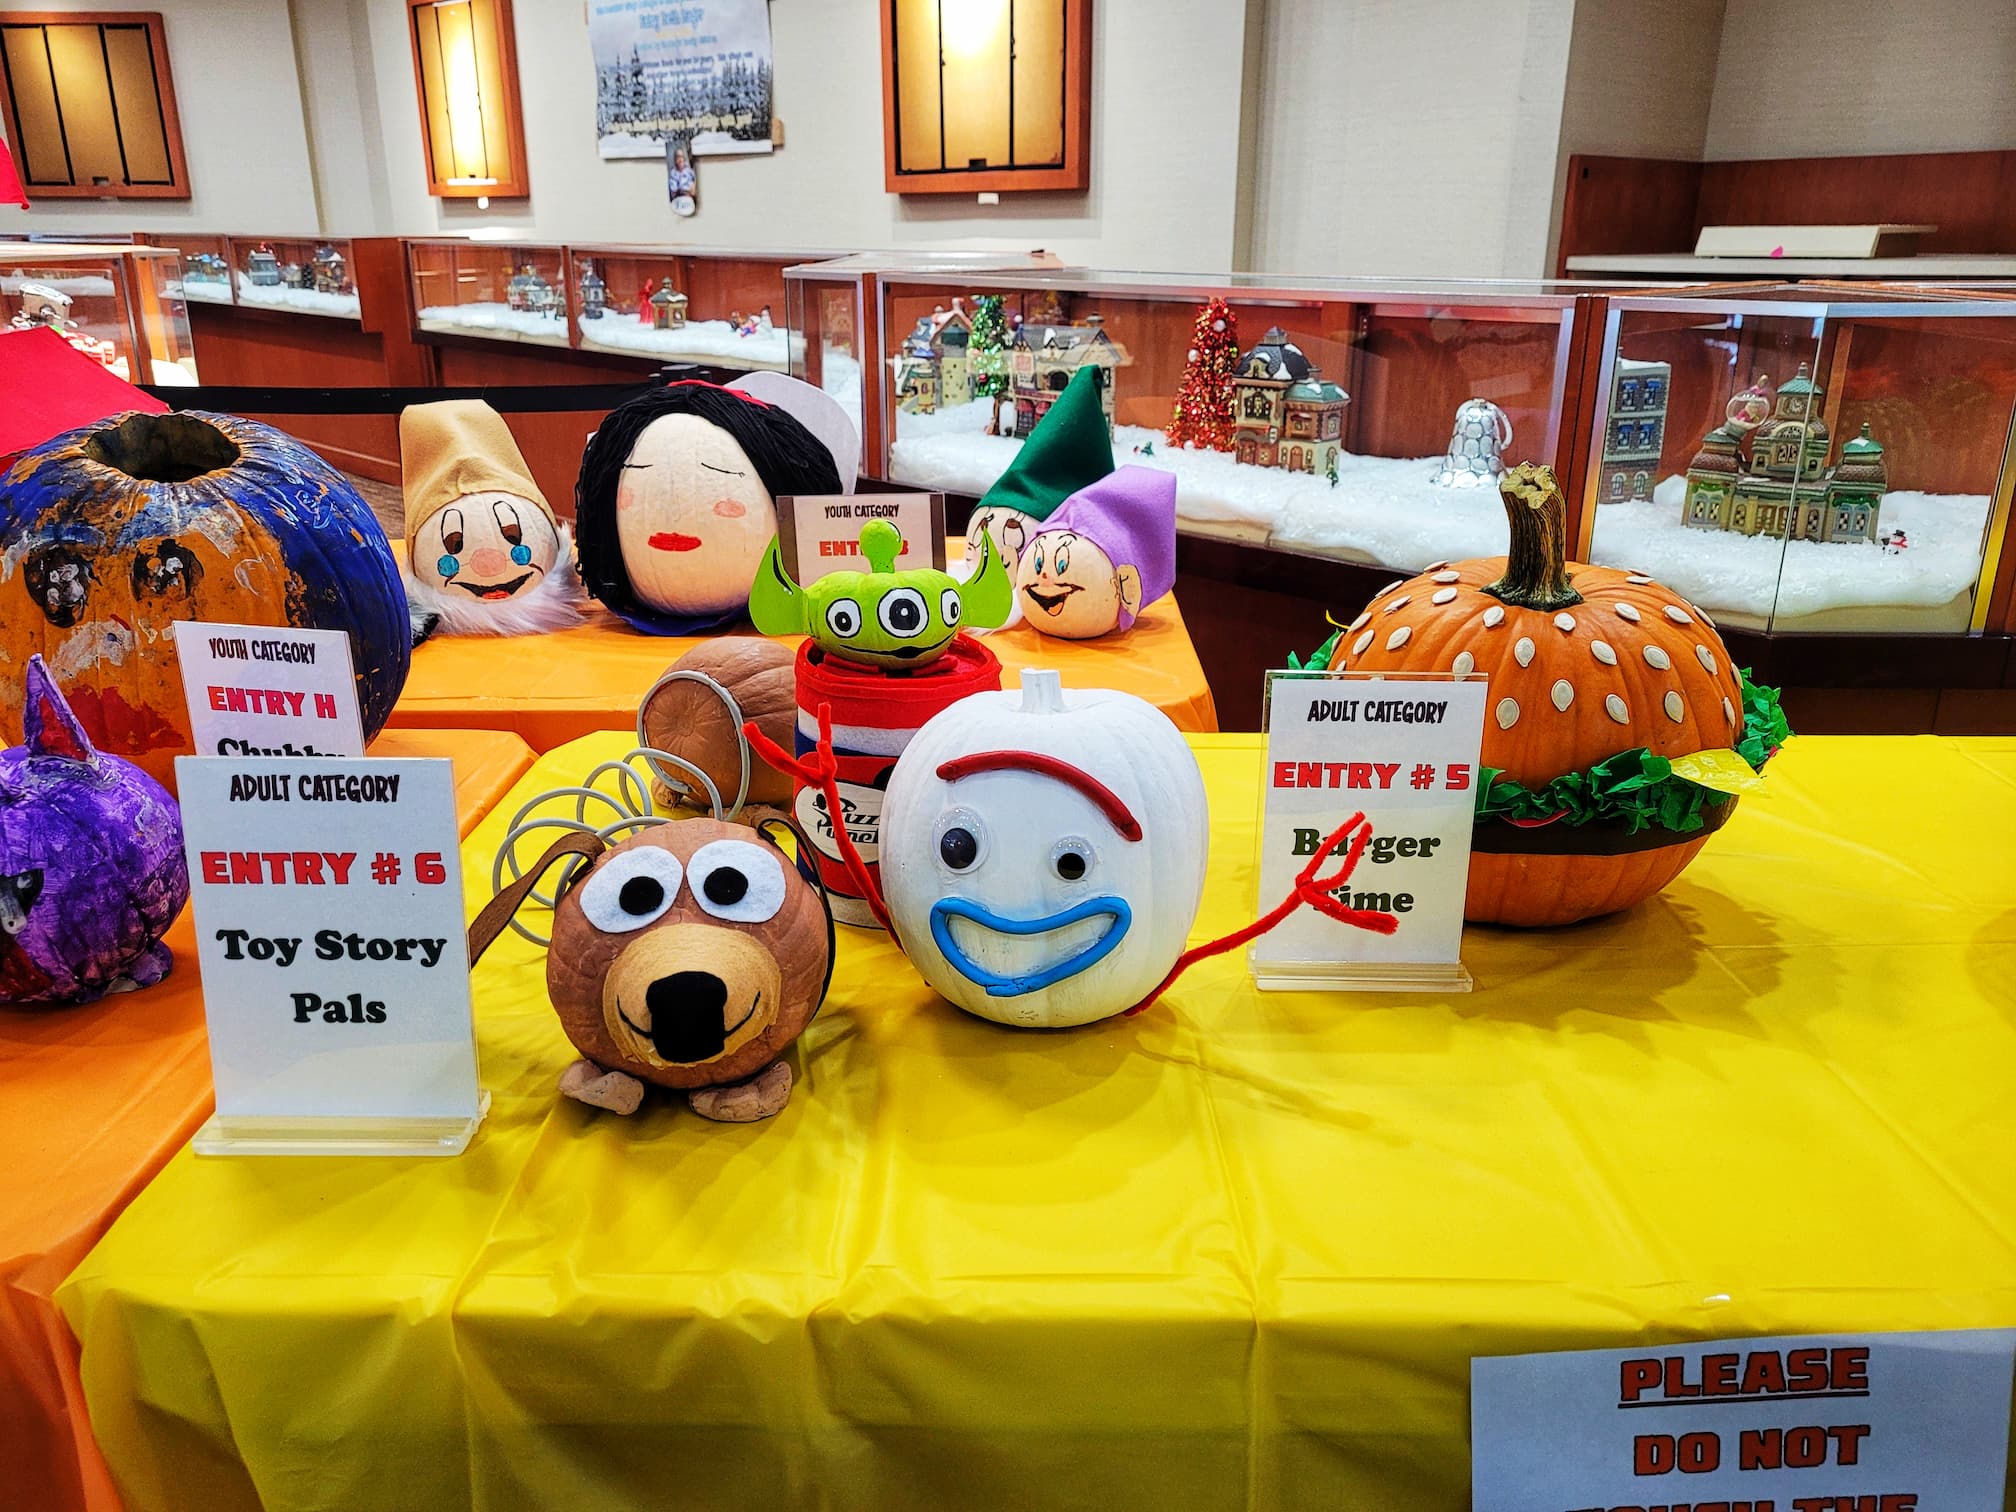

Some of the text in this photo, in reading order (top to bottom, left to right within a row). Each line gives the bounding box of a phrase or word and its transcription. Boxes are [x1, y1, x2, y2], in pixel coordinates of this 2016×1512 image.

[824, 504, 900, 519] YOUTH CATEGORY
[819, 540, 864, 557] ENT
[208, 637, 316, 664] YOUTH CATEGORY
[207, 685, 338, 719] ENTRY H
[1306, 699, 1449, 724] ADULT CATEGORY
[217, 737, 347, 757] Chubb
[229, 773, 400, 803] ADULT CATEGORY
[1273, 761, 1471, 790] ENTRY # 5
[811, 793, 880, 826] Pizz
[200, 851, 447, 885] ENTRY # 6
[215, 929, 448, 968] Toy Story
[290, 992, 387, 1023] Pals
[1620, 1347, 1870, 1402] PLEASE
[1633, 1424, 1871, 1477] DO NOT
